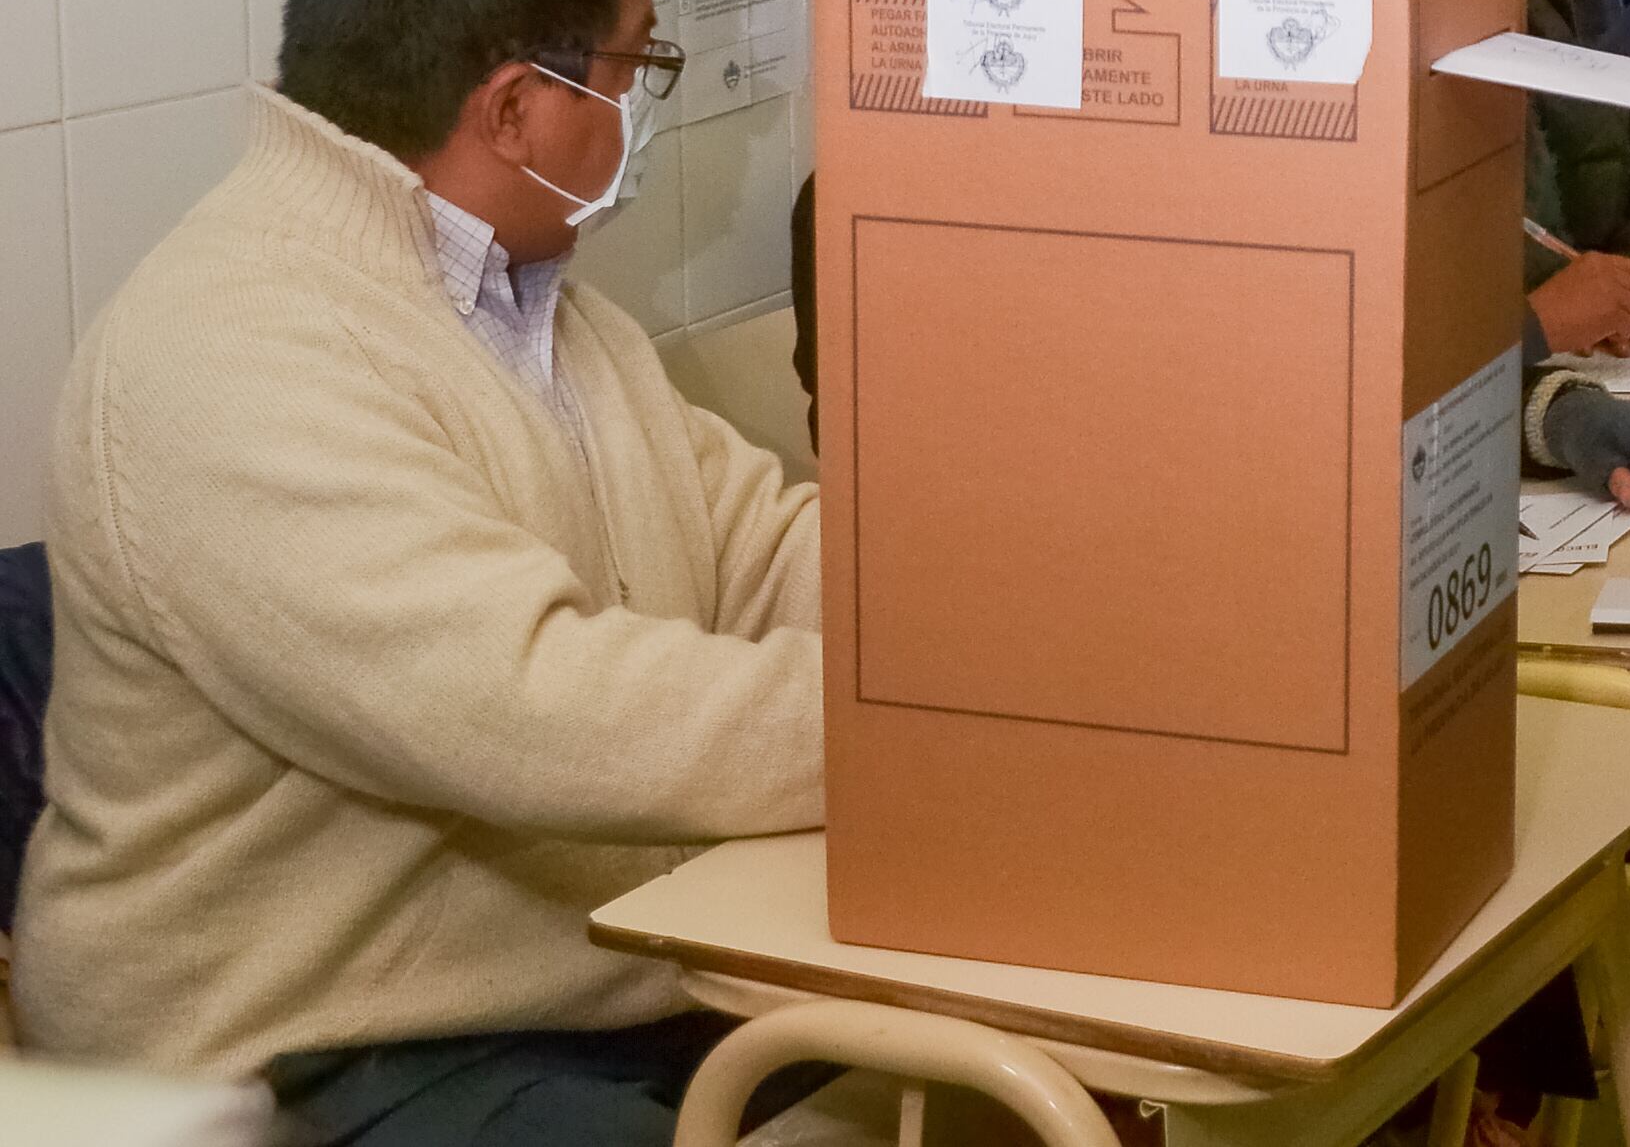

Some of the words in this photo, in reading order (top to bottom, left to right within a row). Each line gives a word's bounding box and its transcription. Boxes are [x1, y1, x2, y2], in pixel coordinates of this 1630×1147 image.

[871, 9, 911, 21] PEGAR
[871, 42, 885, 53] AL
[871, 56, 886, 69] LA
[889, 57, 922, 70] URNA
[1235, 79, 1250, 91] LA
[1254, 81, 1288, 93] URNA
[1118, 91, 1164, 107] LADO
[1429, 542, 1491, 650] 0869
